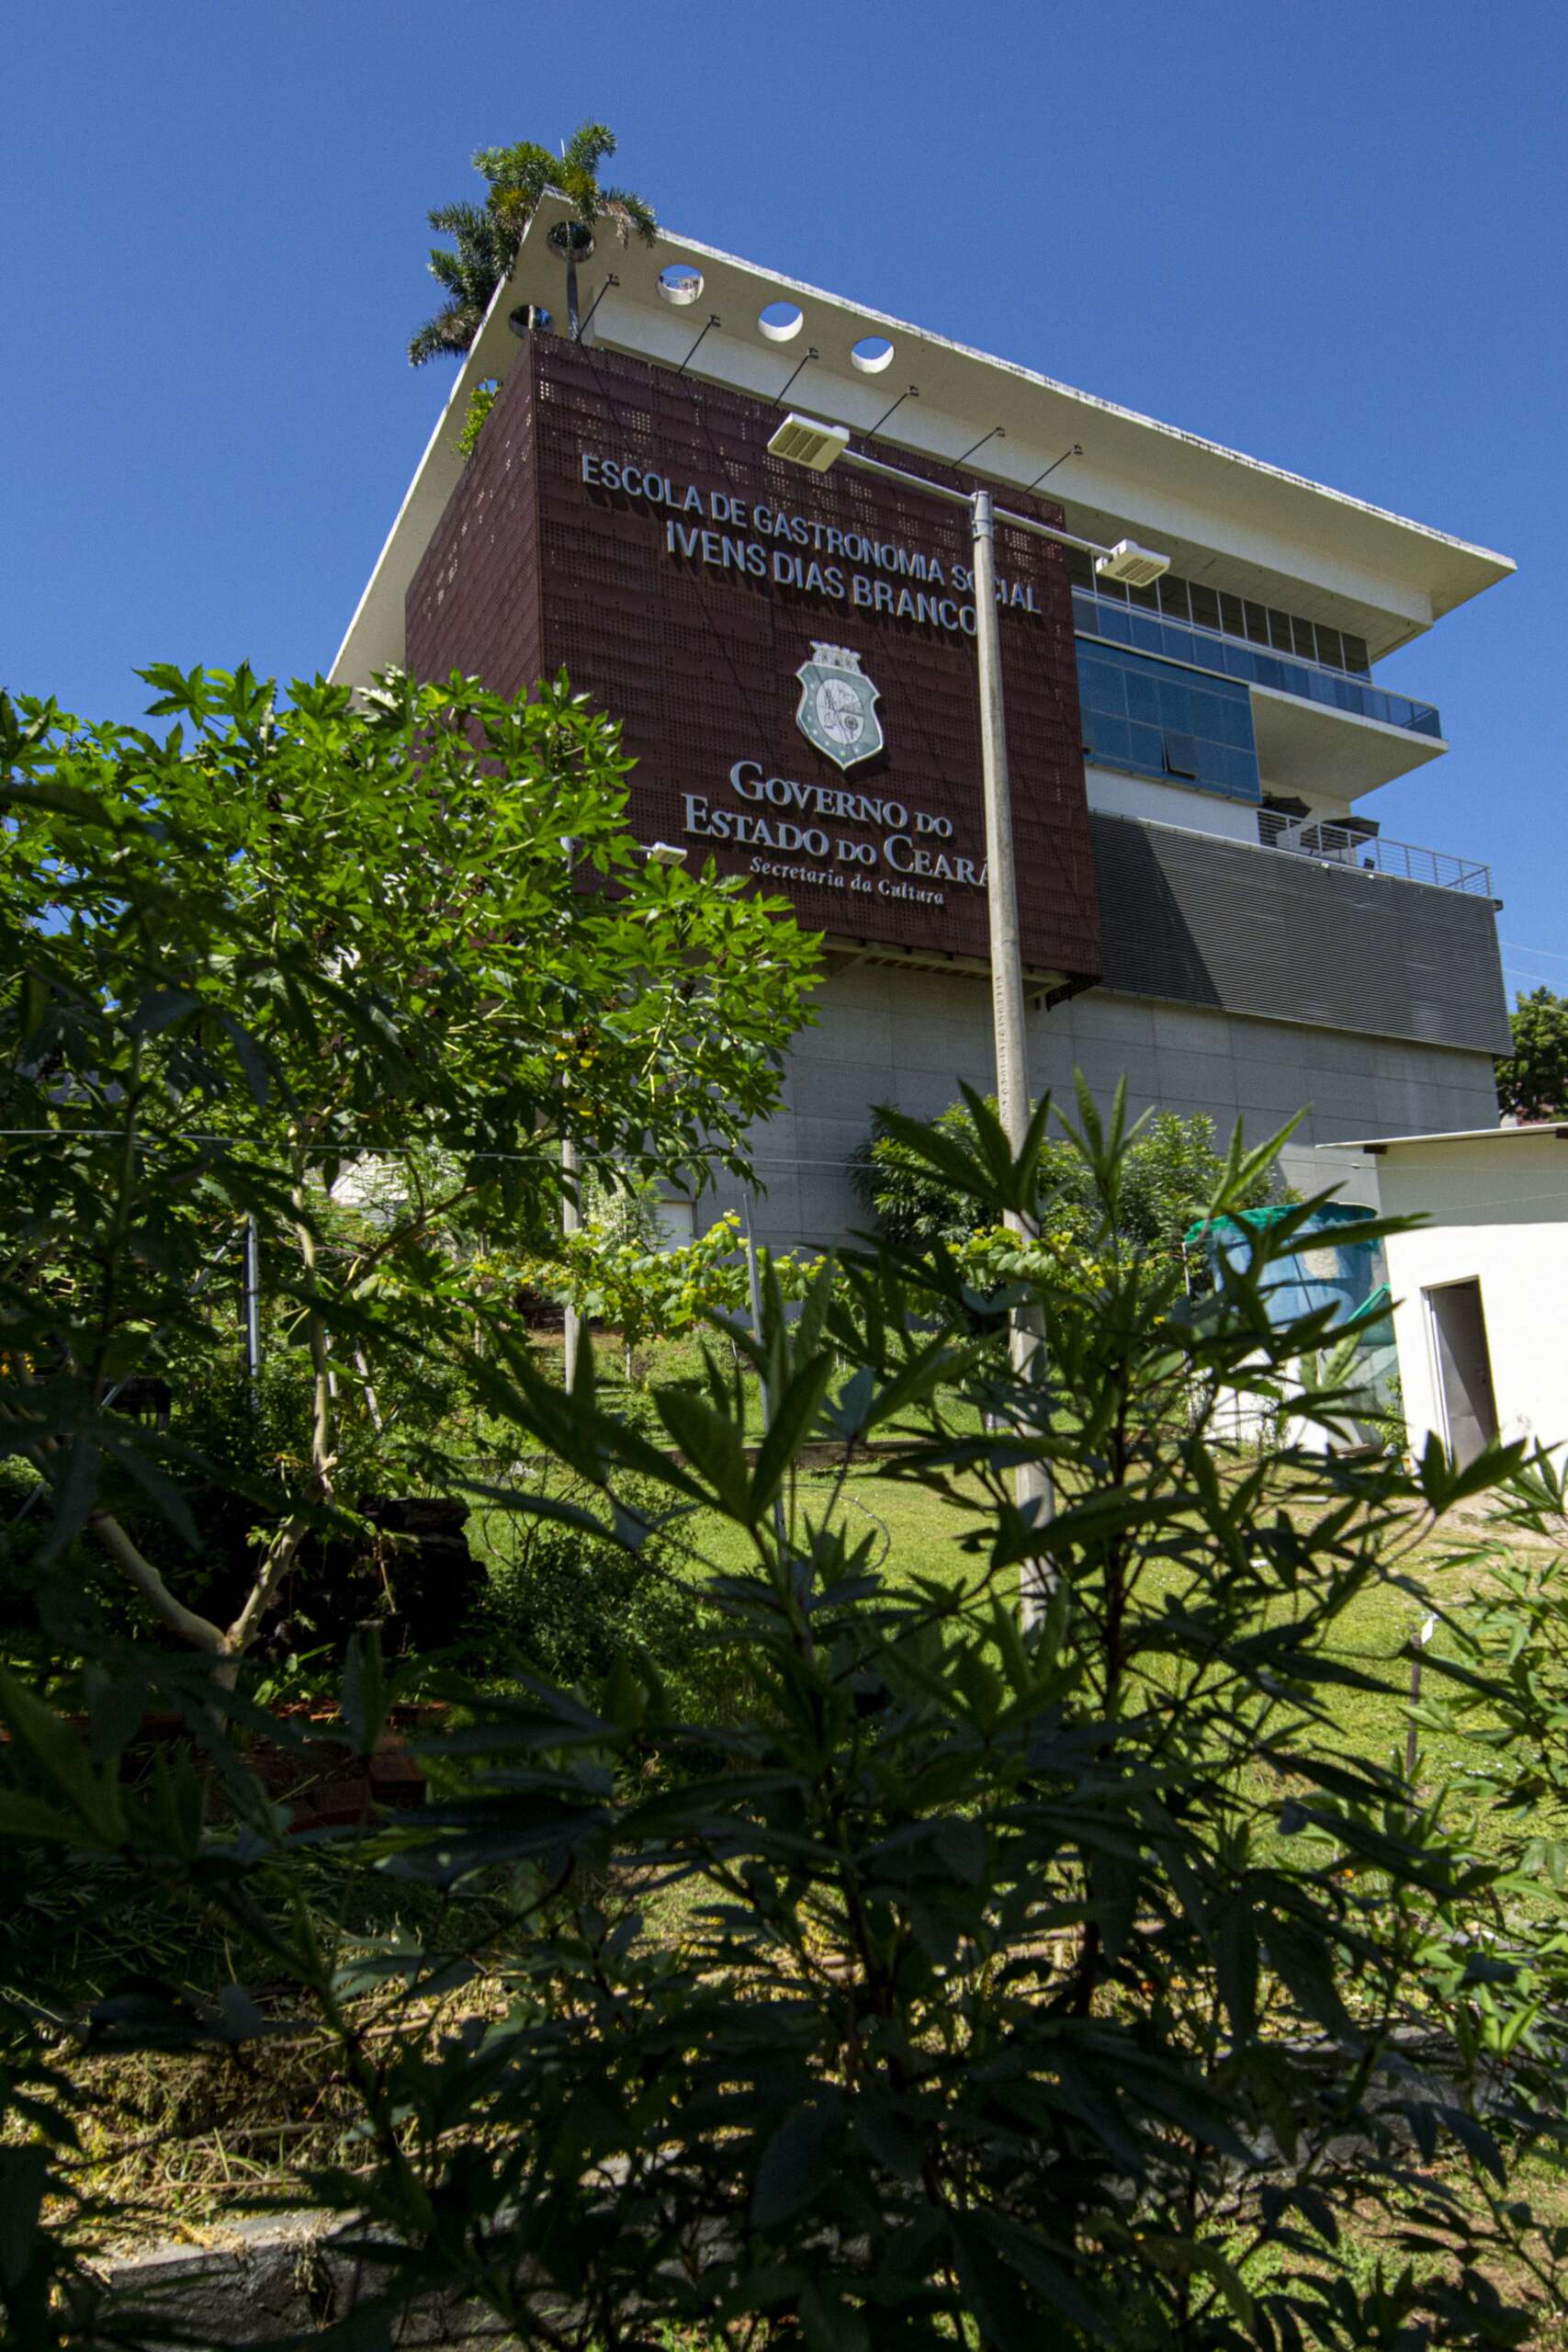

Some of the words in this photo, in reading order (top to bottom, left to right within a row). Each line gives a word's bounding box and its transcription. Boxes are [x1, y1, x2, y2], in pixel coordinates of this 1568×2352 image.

[582, 454, 704, 515] ESCOLA
[710, 492, 748, 528] DE
[753, 505, 945, 586] GASTRONOMIA
[667, 520, 766, 576] IVENS
[773, 550, 845, 598] DIAS
[852, 573, 977, 637] BRANCO
[681, 792, 829, 856] ESTADO
[836, 838, 877, 865] DO
[730, 761, 908, 829] GOVERNO
[914, 811, 953, 838] DO
[750, 855, 844, 888] Secretaria
[851, 874, 873, 893] da
[878, 878, 944, 906] Cultura
